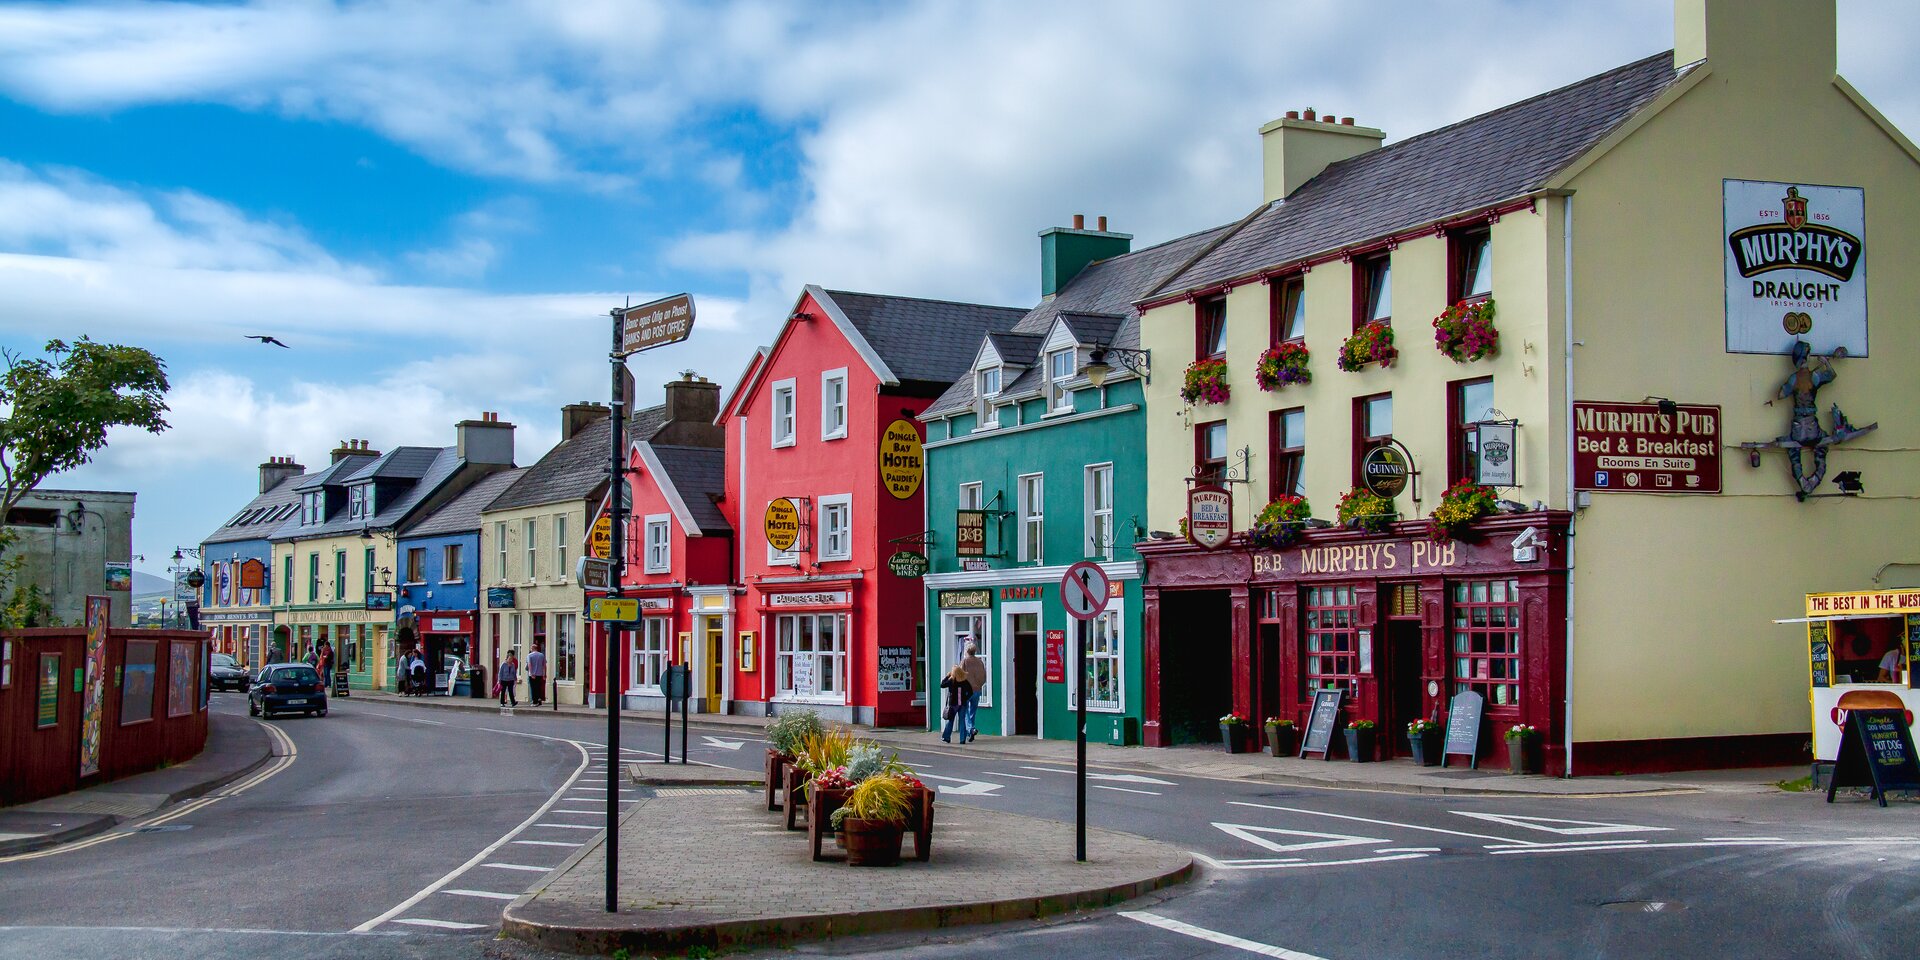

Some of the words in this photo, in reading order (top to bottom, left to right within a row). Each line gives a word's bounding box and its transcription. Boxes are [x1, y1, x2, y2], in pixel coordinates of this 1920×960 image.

[1812, 213, 1831, 222] 1856
[1740, 232, 1853, 269] MURPHY'S
[1752, 281, 1841, 302] DRAUGHT
[626, 319, 639, 330] Banc
[640, 316, 651, 328] agus
[664, 310, 671, 319] an
[625, 331, 641, 345] BANKS
[641, 328, 652, 342] AND
[652, 325, 667, 339] POST
[667, 320, 686, 335] OFFICE
[1576, 408, 1671, 434] MURPHY'S
[1677, 411, 1716, 435] PUB
[888, 431, 918, 441] DINGLE
[893, 443, 911, 452] BAY
[1577, 436, 1610, 453] Bed
[1617, 437, 1629, 454] &
[1636, 438, 1716, 457] Breakfast
[883, 452, 922, 468] HOTEL
[1601, 459, 1641, 469] Rooms
[1645, 460, 1659, 469] En
[1663, 460, 1691, 470] Suite
[1368, 462, 1406, 475] GUINNESS
[886, 473, 918, 483] PAUDIE'S
[893, 484, 910, 492] BAR
[1194, 493, 1228, 505] MURPHY'S
[1202, 504, 1213, 512] BED
[1215, 504, 1220, 512] &
[1194, 512, 1228, 521] BREAKFAST
[768, 520, 797, 530] HOTEL
[595, 532, 611, 542] BA
[959, 528, 983, 542] B&B
[599, 550, 611, 558] HOT
[1301, 542, 1396, 574] MURPHY'S
[1411, 540, 1456, 569] PUB
[1000, 586, 1043, 600] MURPHY
[1812, 597, 1829, 611] THE
[1833, 596, 1855, 611] BEST
[1860, 595, 1870, 609] IN
[1874, 594, 1894, 609] THE
[299, 611, 317, 622] DINGLE
[320, 610, 345, 621] WOOLLEN
[347, 610, 373, 621] COMPANY
[1873, 741, 1887, 751] HOT
[1887, 740, 1903, 750] DOG
